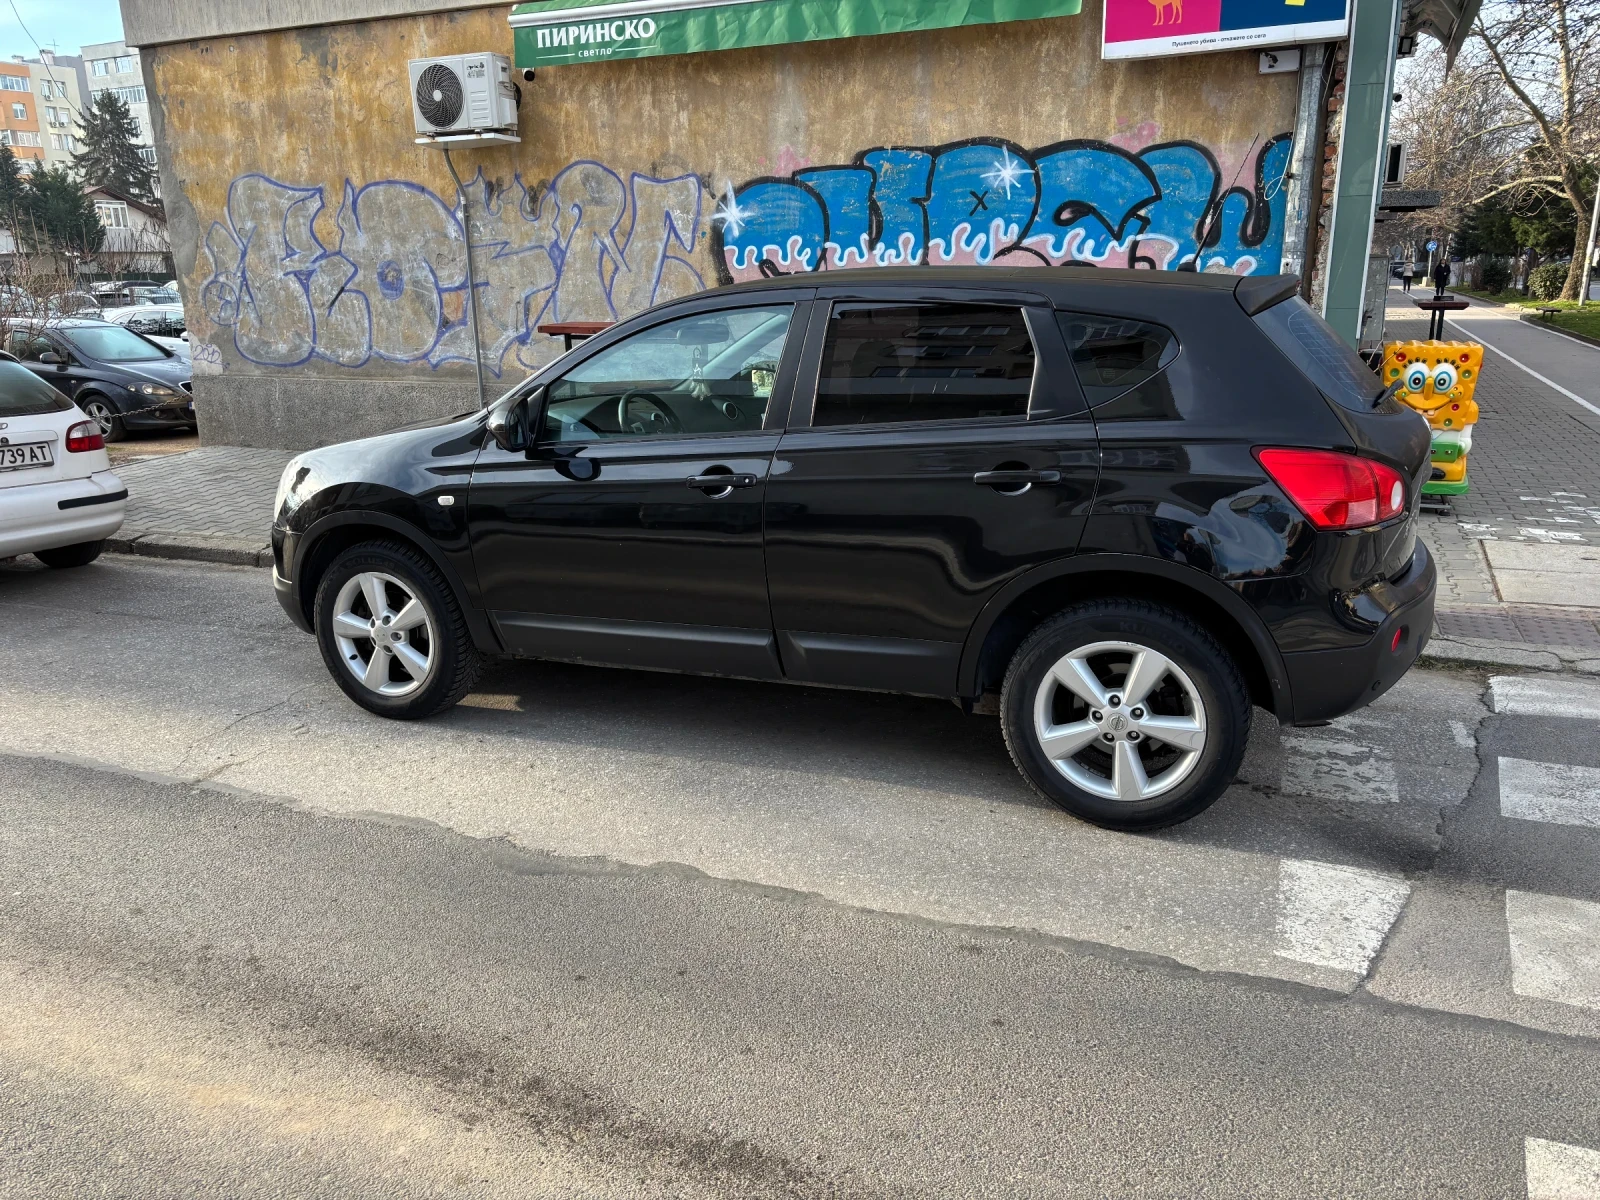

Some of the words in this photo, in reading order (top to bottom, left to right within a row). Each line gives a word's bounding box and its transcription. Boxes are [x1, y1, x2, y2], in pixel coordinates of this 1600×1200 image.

[536, 17, 656, 48] ПИРИНСКО
[578, 47, 612, 58] светло
[30, 445, 46, 462] AT
